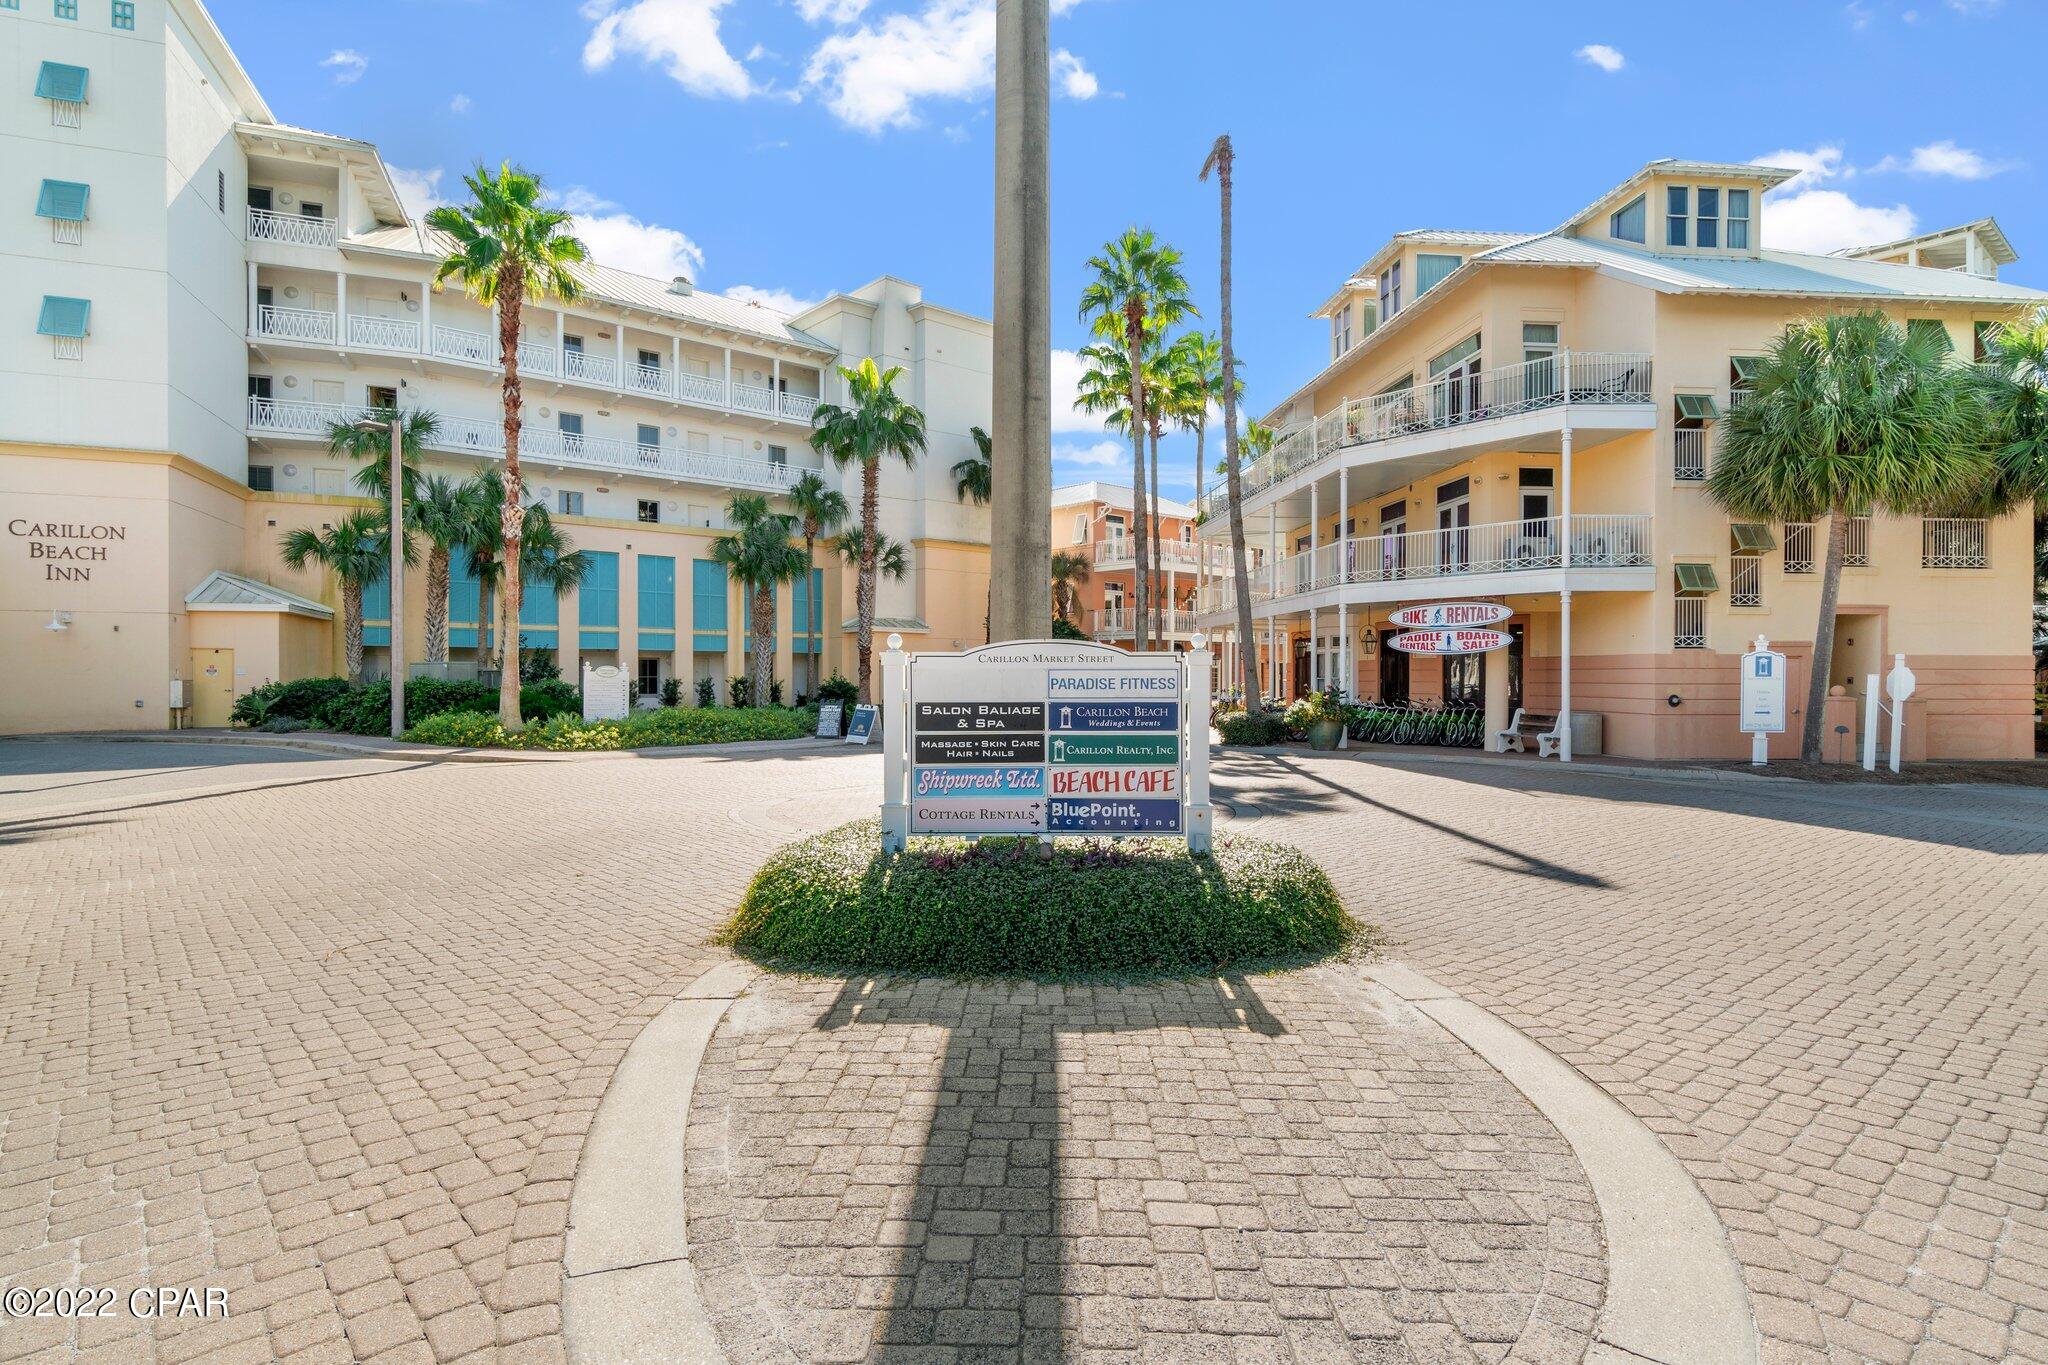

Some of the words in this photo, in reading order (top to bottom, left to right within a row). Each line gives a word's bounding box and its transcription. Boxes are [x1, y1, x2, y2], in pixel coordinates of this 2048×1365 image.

[8, 519, 126, 540] CARILLON
[29, 542, 107, 560] BEACH
[46, 564, 90, 581] INN
[1402, 609, 1427, 624] BIKE
[1446, 606, 1498, 624] RENTALS
[1400, 632, 1442, 642] PADDLE
[1456, 631, 1499, 641] BOARD
[1400, 642, 1436, 651] RENTALS
[1463, 640, 1499, 650] SALES
[978, 654, 1030, 663] CARILLON
[1033, 654, 1074, 663] MARKET
[1078, 653, 1114, 663] STREET
[1050, 678, 1116, 690] PARADISE
[1120, 678, 1176, 690] FITNESS
[921, 705, 972, 715] SALON
[978, 705, 1041, 715] BALIAGE
[1076, 707, 1131, 717] CARILLON
[1134, 706, 1169, 717] BEACH
[957, 719, 969, 728] &
[975, 719, 1005, 728] SPA
[1088, 719, 1125, 728] Weddings
[1126, 719, 1134, 727] &
[1135, 719, 1161, 727] Events
[921, 741, 973, 749] MASSAGE
[981, 740, 1007, 748] SKIN
[1011, 740, 1041, 748] CARE
[982, 750, 1015, 758] NAILS
[1066, 745, 1114, 755] CARILLON
[1116, 745, 1154, 756] REALTY,
[1156, 745, 1176, 755] INC.
[917, 769, 1003, 795] Shipwreck
[1006, 769, 1041, 789] Ltd.
[1053, 770, 1120, 794] BEACH
[1123, 769, 1175, 793] CAFE
[919, 808, 976, 820] COTTAGE
[979, 808, 1035, 820] RENTALS
[1051, 802, 1141, 818] BluePoint.
[1051, 818, 1176, 827] Accounting
